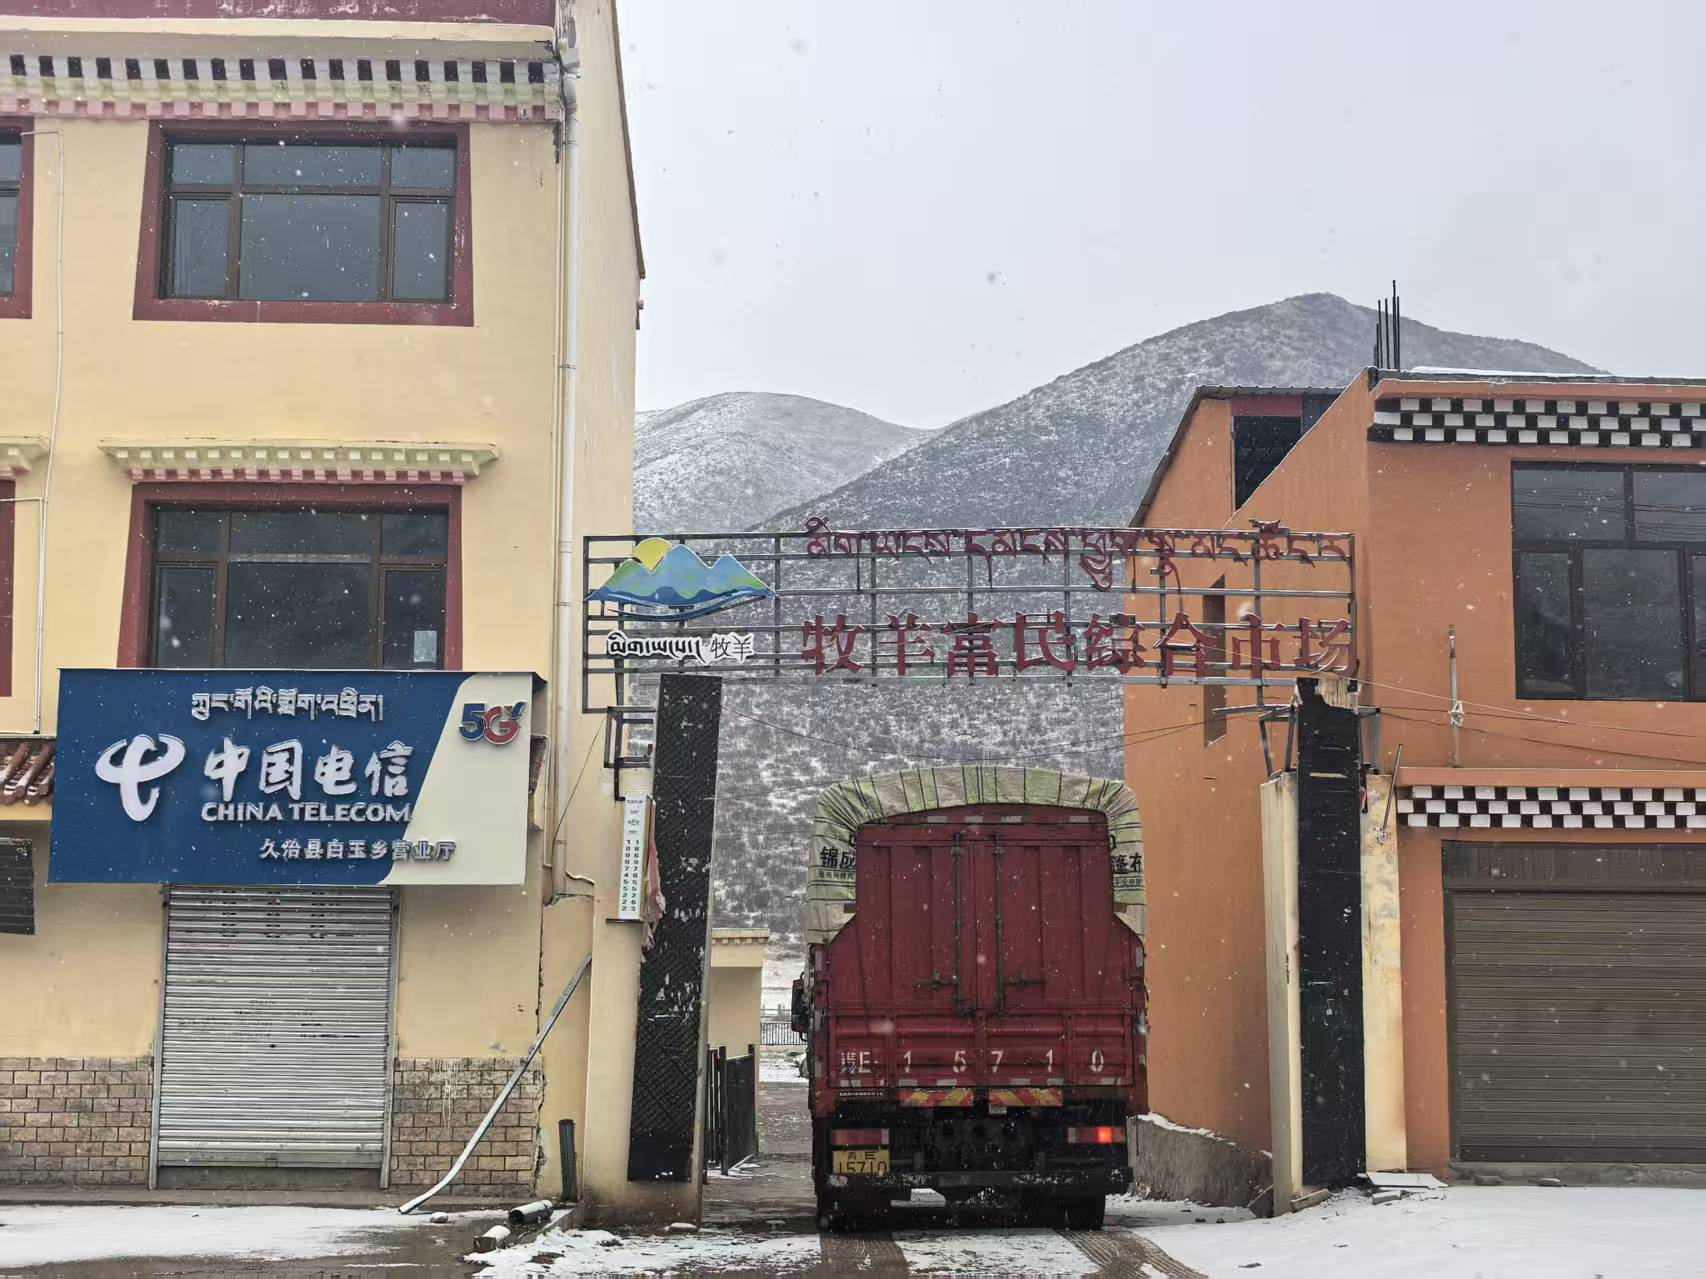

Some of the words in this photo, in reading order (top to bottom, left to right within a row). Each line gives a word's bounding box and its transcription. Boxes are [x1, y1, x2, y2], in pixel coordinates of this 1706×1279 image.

[711, 635, 753, 662] 牧羊
[802, 611, 1357, 678] 牧羊富民综合市场
[458, 702, 523, 745] 5G
[203, 737, 415, 802] 中国电信
[200, 802, 286, 823] CHINA
[289, 802, 413, 823] TELECOM
[259, 838, 457, 862] 久治县白玉乡营业厅
